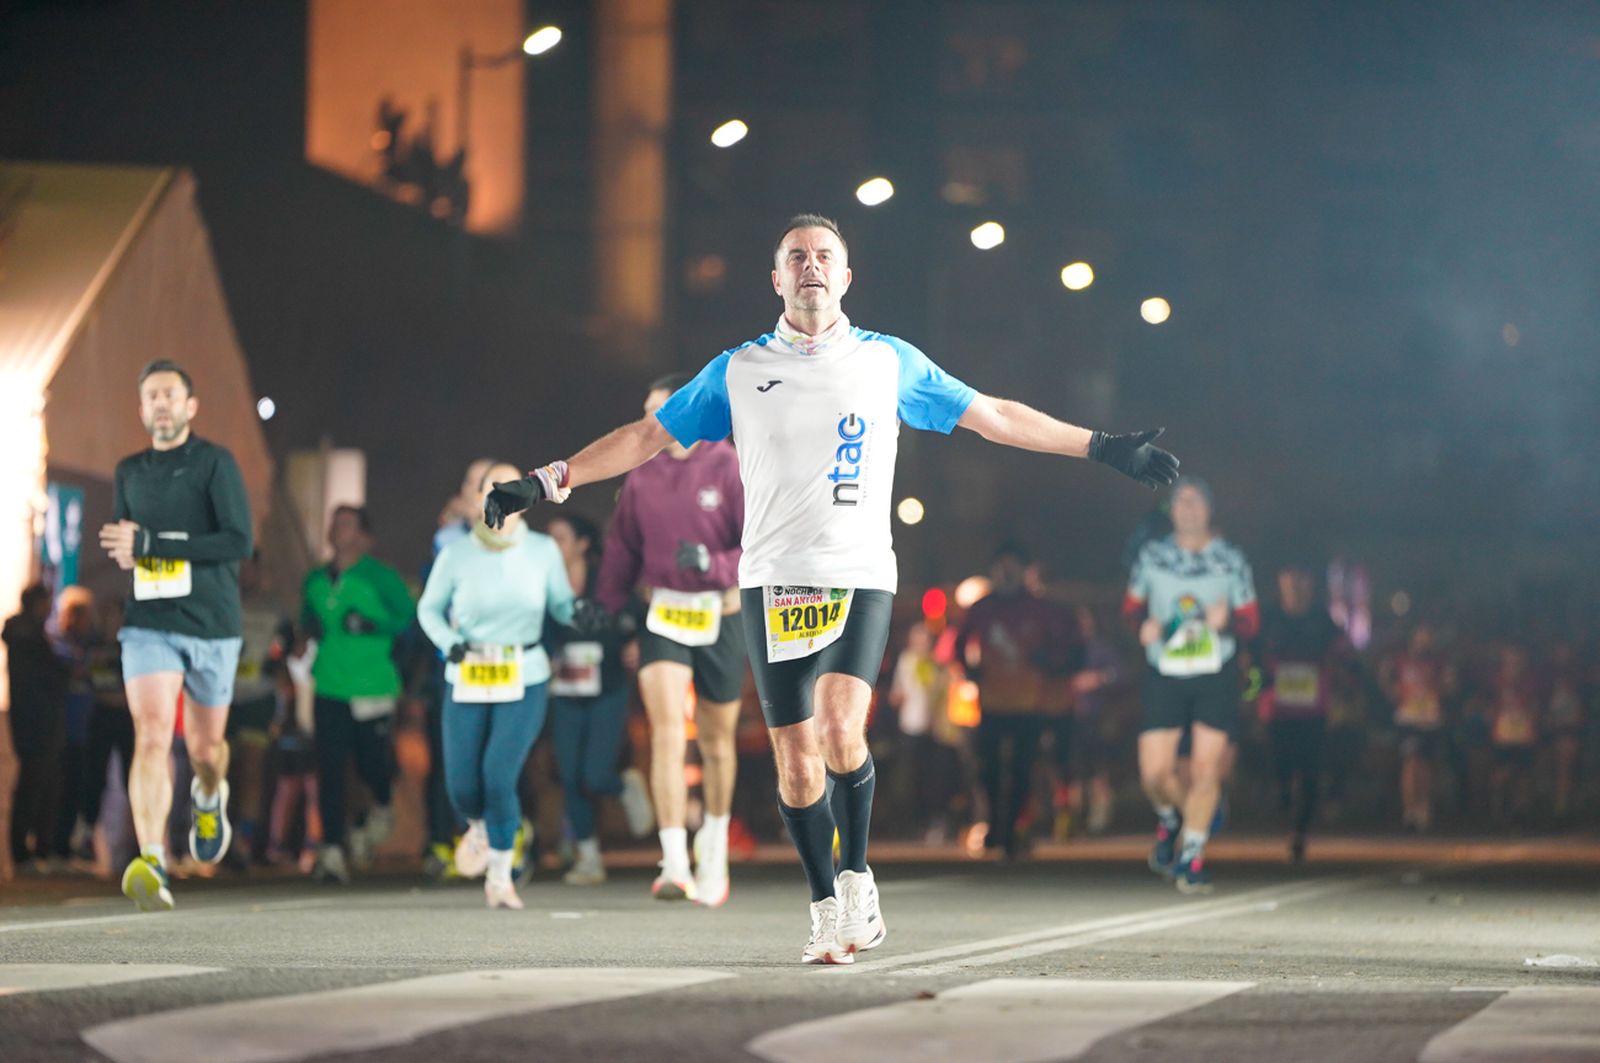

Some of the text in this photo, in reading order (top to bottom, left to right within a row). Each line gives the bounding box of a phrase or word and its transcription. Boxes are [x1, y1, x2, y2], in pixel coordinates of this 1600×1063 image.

[774, 595, 823, 608] SAN ANTON
[779, 602, 841, 632] 12014
